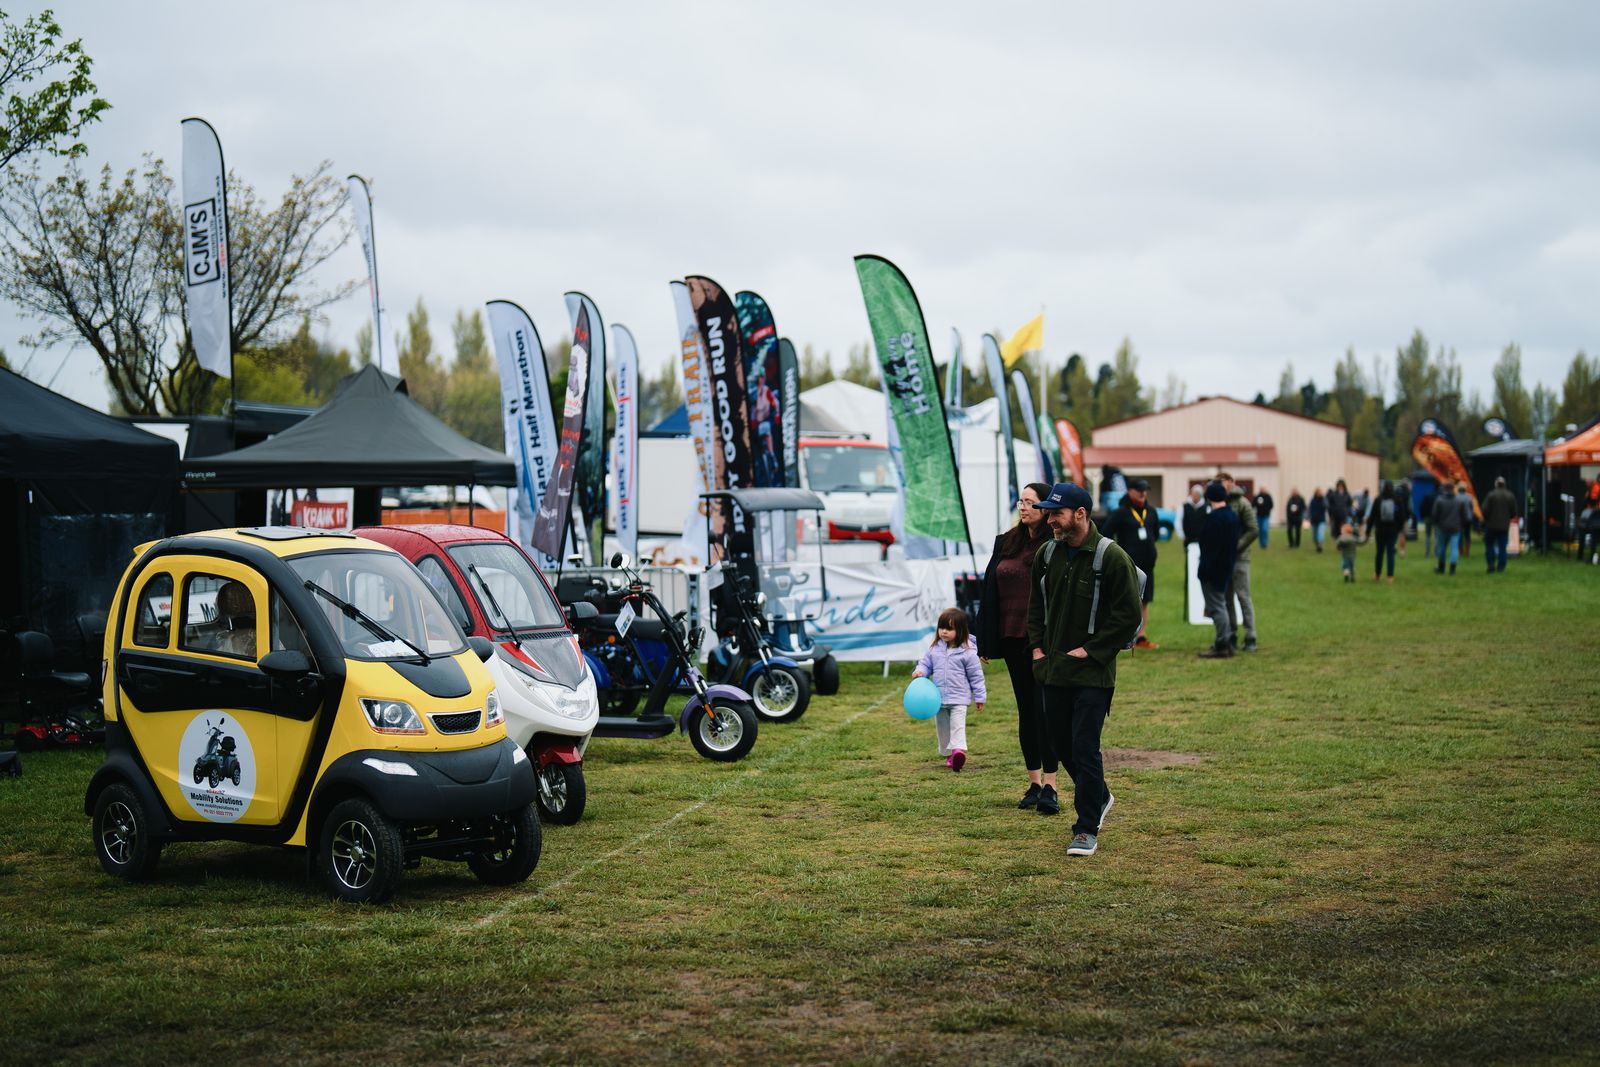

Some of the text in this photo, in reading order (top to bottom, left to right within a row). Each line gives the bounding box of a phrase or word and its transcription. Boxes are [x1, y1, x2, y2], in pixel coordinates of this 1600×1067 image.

[190, 208, 210, 277] CJM'S
[515, 329, 535, 410] Marathon
[681, 330, 703, 422] TRAIL
[706, 316, 726, 375] RUN
[900, 331, 930, 415] Home
[525, 414, 541, 448] Half
[716, 379, 736, 463] GOOD
[190, 792, 243, 806] Mobility Solutions
